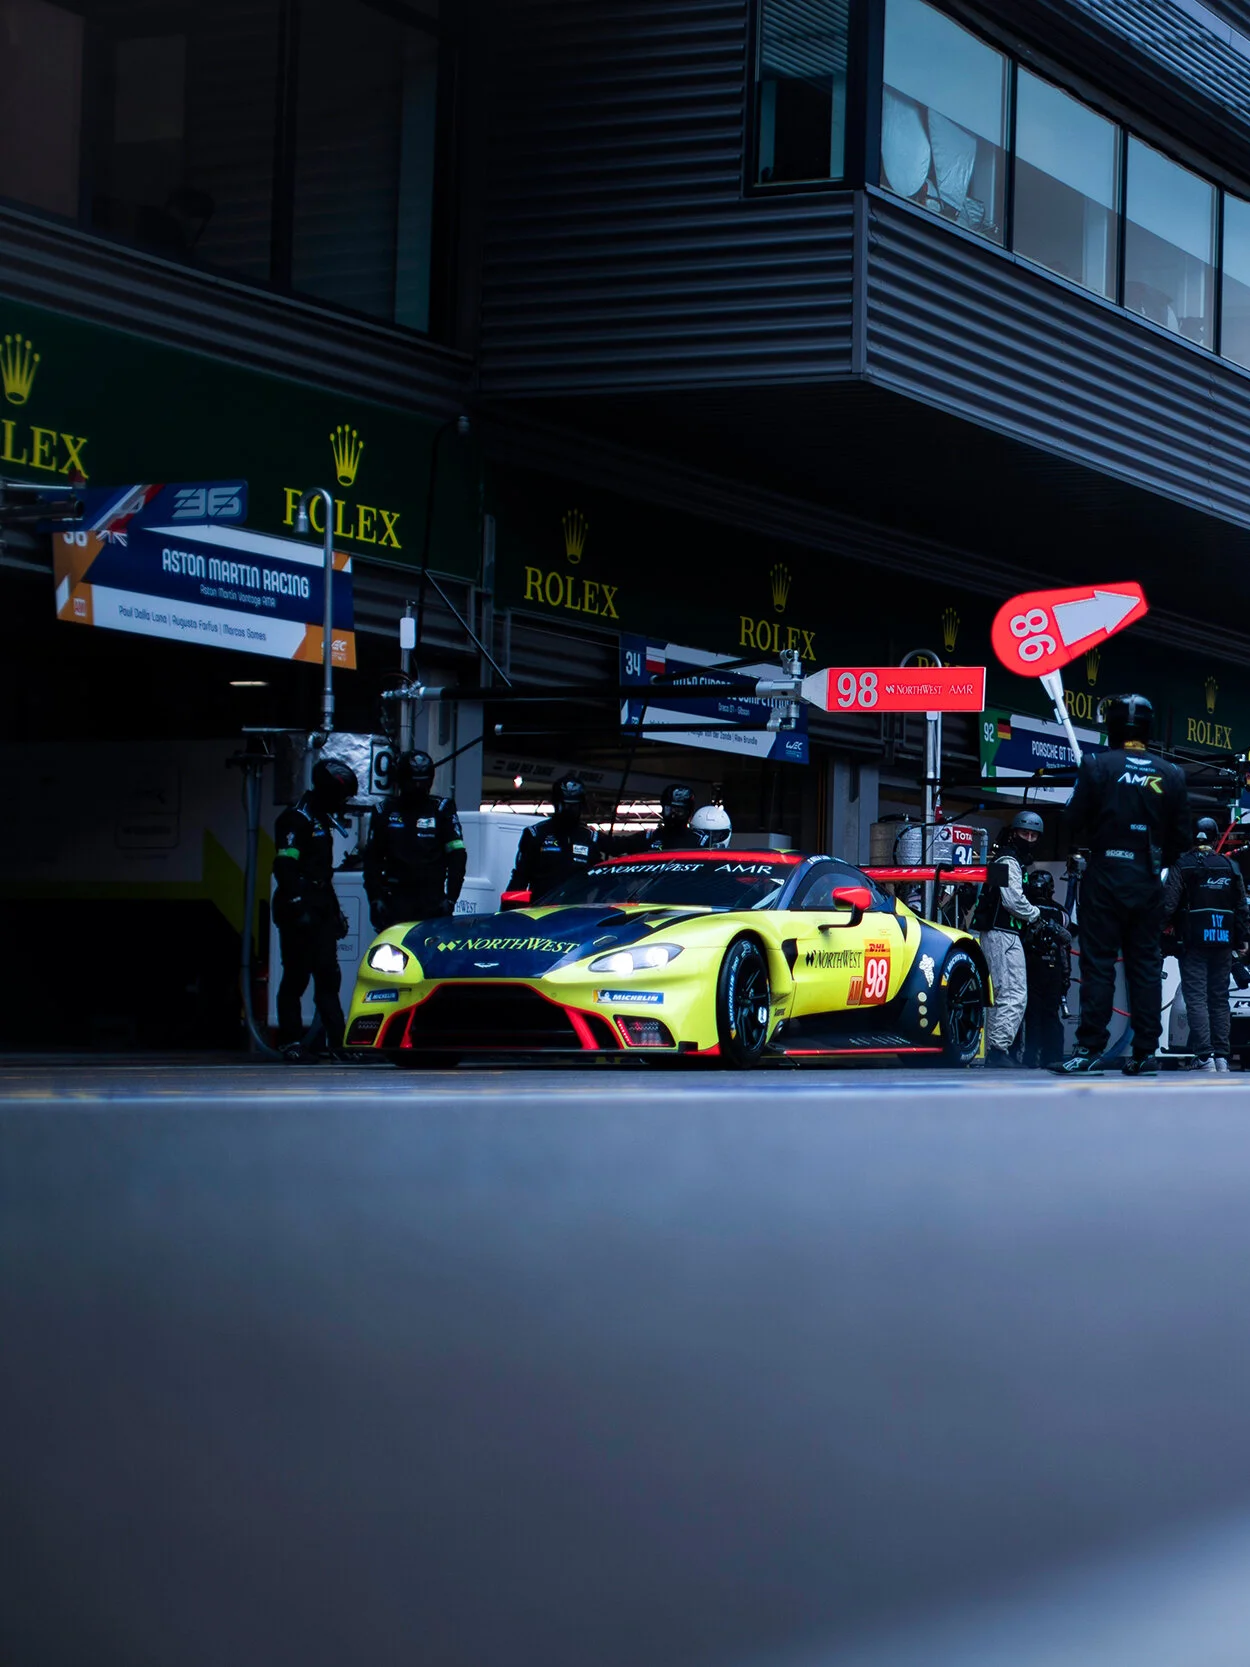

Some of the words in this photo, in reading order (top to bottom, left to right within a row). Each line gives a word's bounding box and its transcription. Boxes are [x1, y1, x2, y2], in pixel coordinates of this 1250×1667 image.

[162, 549, 206, 578] ASTON
[208, 557, 260, 588] MARTIN
[263, 568, 311, 598] RACING
[524, 566, 619, 618] ROLEX
[118, 605, 133, 617] Paul
[134, 608, 150, 620] Dalla
[152, 611, 167, 624] Lana
[740, 616, 816, 661] ROLEX
[1009, 608, 1056, 662] 98
[625, 651, 641, 676] 34
[837, 672, 878, 707] 98
[896, 684, 942, 695] NORTHWEST
[950, 684, 974, 694] AMR
[1064, 689, 1112, 722] ROL
[983, 722, 995, 742] 92
[1187, 717, 1232, 750] ROLEX
[1032, 740, 1058, 759] PORSCHE
[1059, 745, 1066, 760] GT
[1118, 772, 1163, 793] AMR
[714, 864, 772, 874] AMR
[1207, 877, 1231, 885] WEC
[459, 937, 580, 954] NORTHWEST
[1204, 929, 1216, 942] PIT
[868, 943, 885, 952] DHL
[815, 950, 862, 968] NORTHWEST
[865, 958, 888, 998] 98
